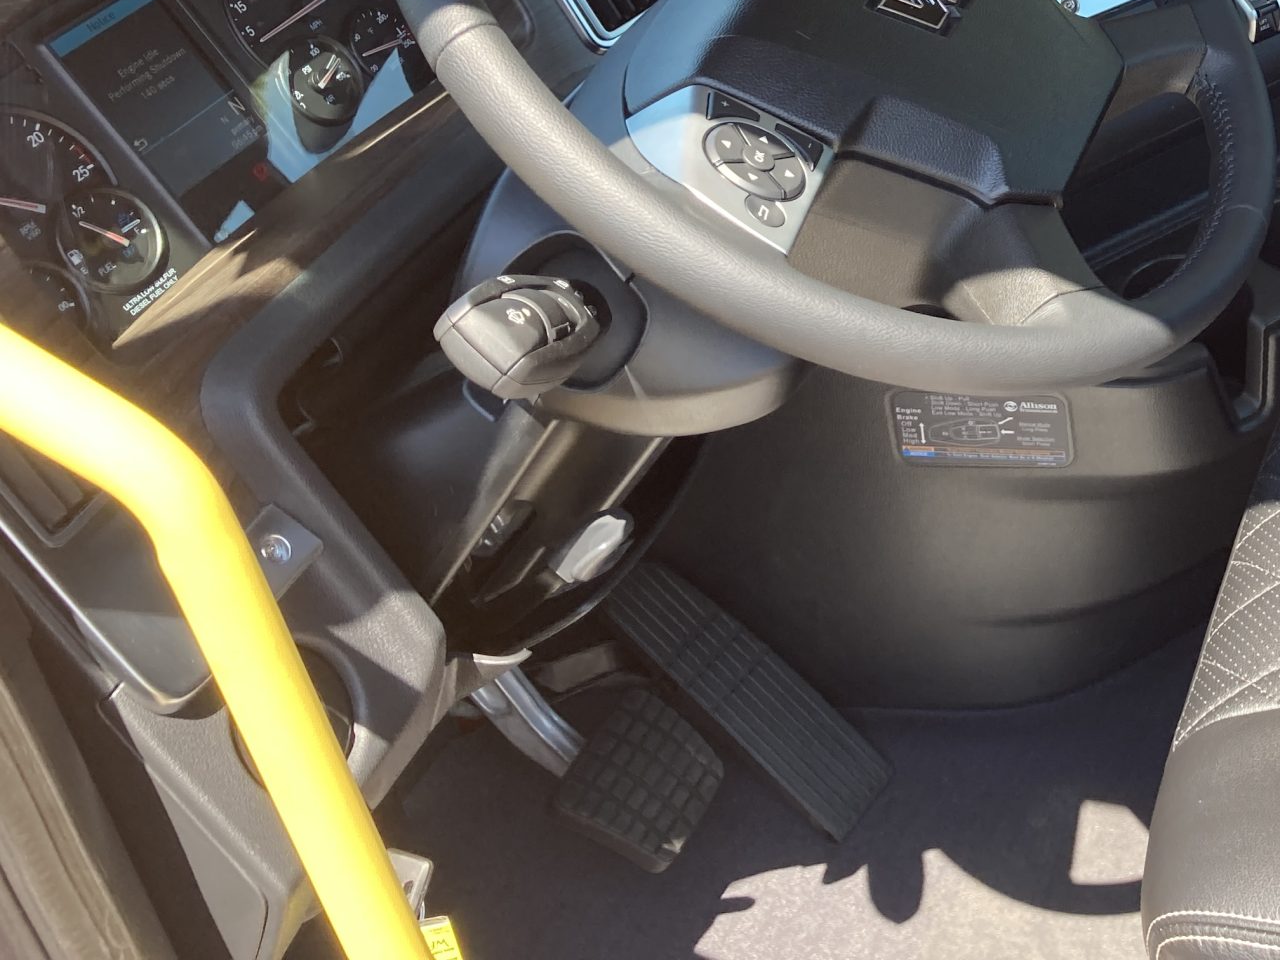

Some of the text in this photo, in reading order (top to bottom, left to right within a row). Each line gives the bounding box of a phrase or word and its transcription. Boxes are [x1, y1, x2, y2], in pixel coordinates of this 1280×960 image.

[233, 0, 247, 14] 15
[246, 25, 255, 37] 5
[309, 46, 320, 58] 100
[117, 58, 144, 78] Engine
[227, 96, 246, 115] N
[27, 130, 44, 147] 20
[754, 150, 765, 163] OK
[72, 166, 90, 182] 25
[98, 262, 117, 276] FUEL
[123, 293, 145, 312] ULTRA
[153, 267, 177, 288] SULFUR
[129, 275, 179, 317] DIESEL FUEL ONLY
[1020, 401, 1057, 410] Allison
